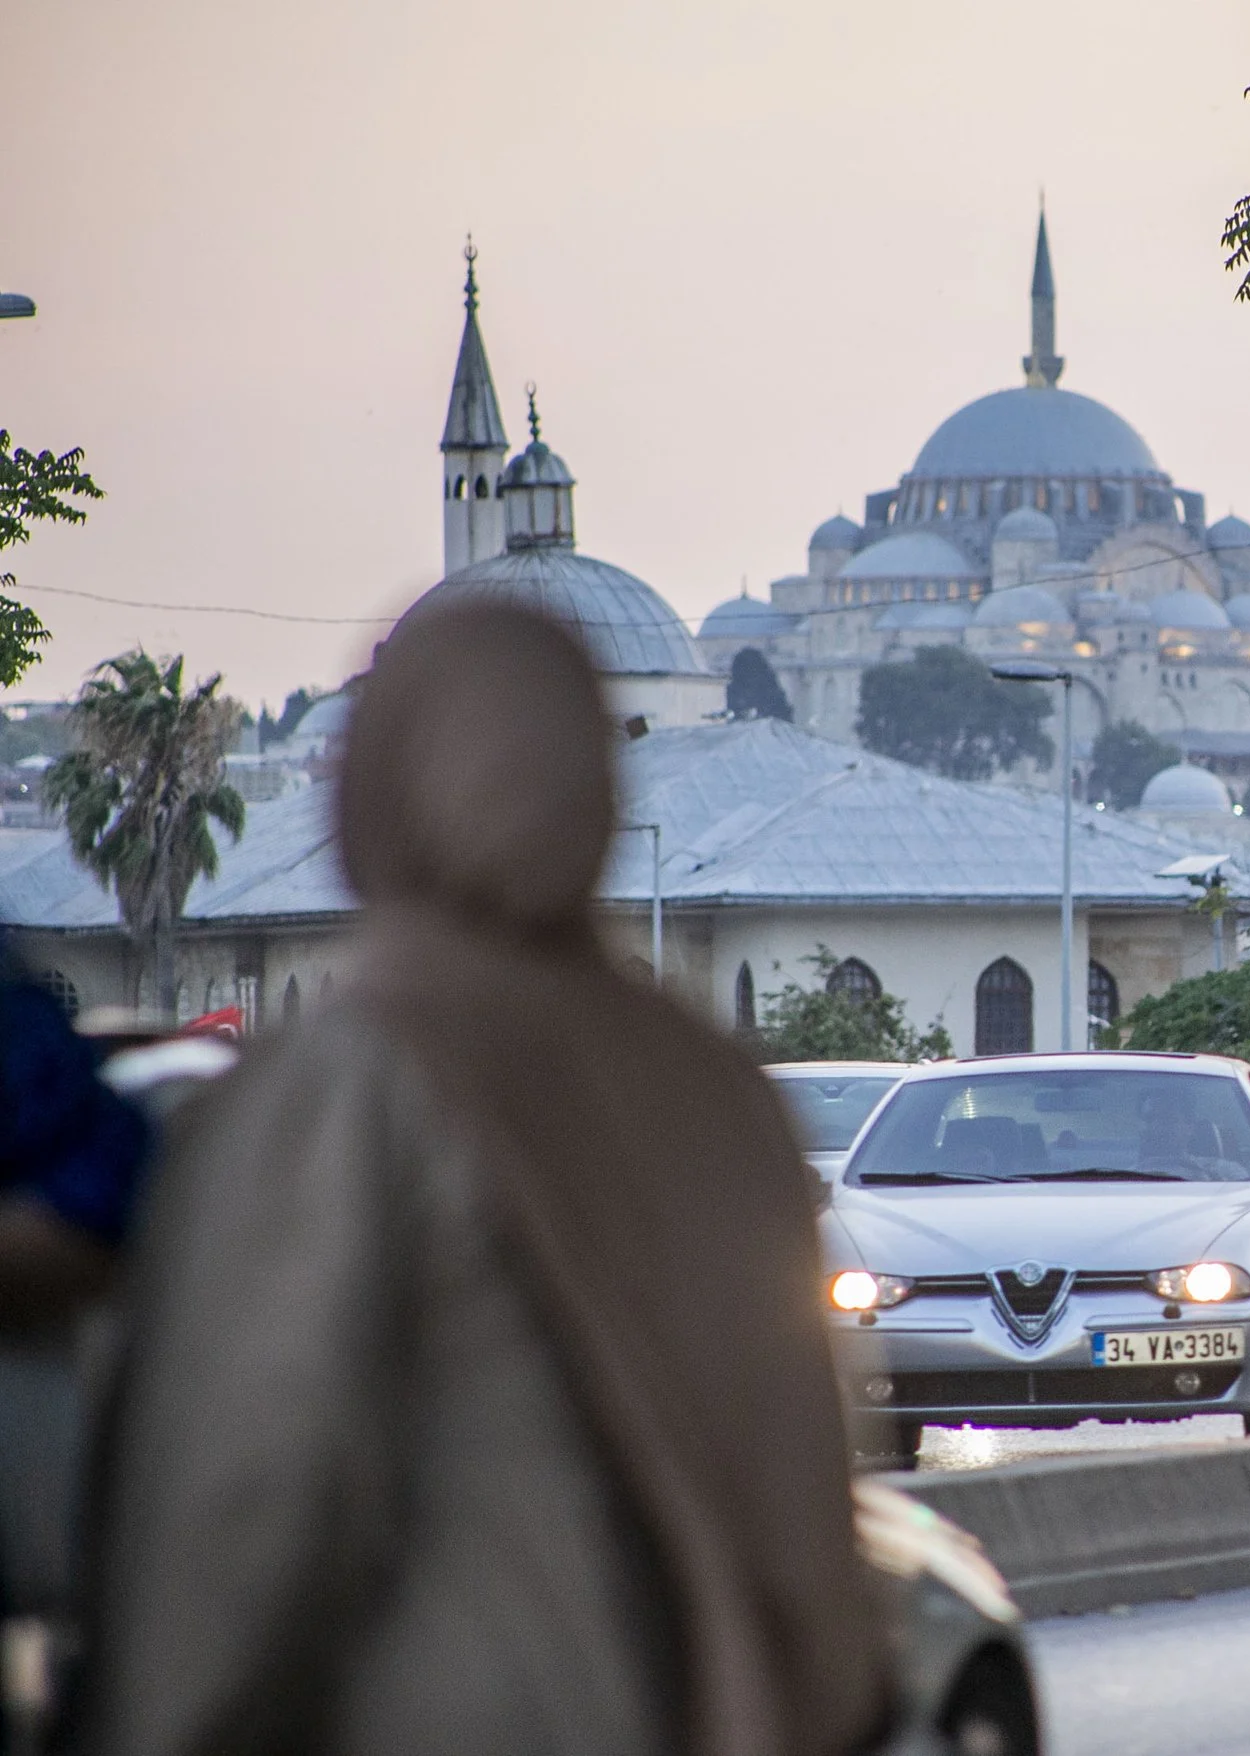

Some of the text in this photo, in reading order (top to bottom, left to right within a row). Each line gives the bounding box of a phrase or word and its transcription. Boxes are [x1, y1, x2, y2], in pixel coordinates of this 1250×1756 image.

[1107, 1331, 1239, 1362] 34 VA 3384
